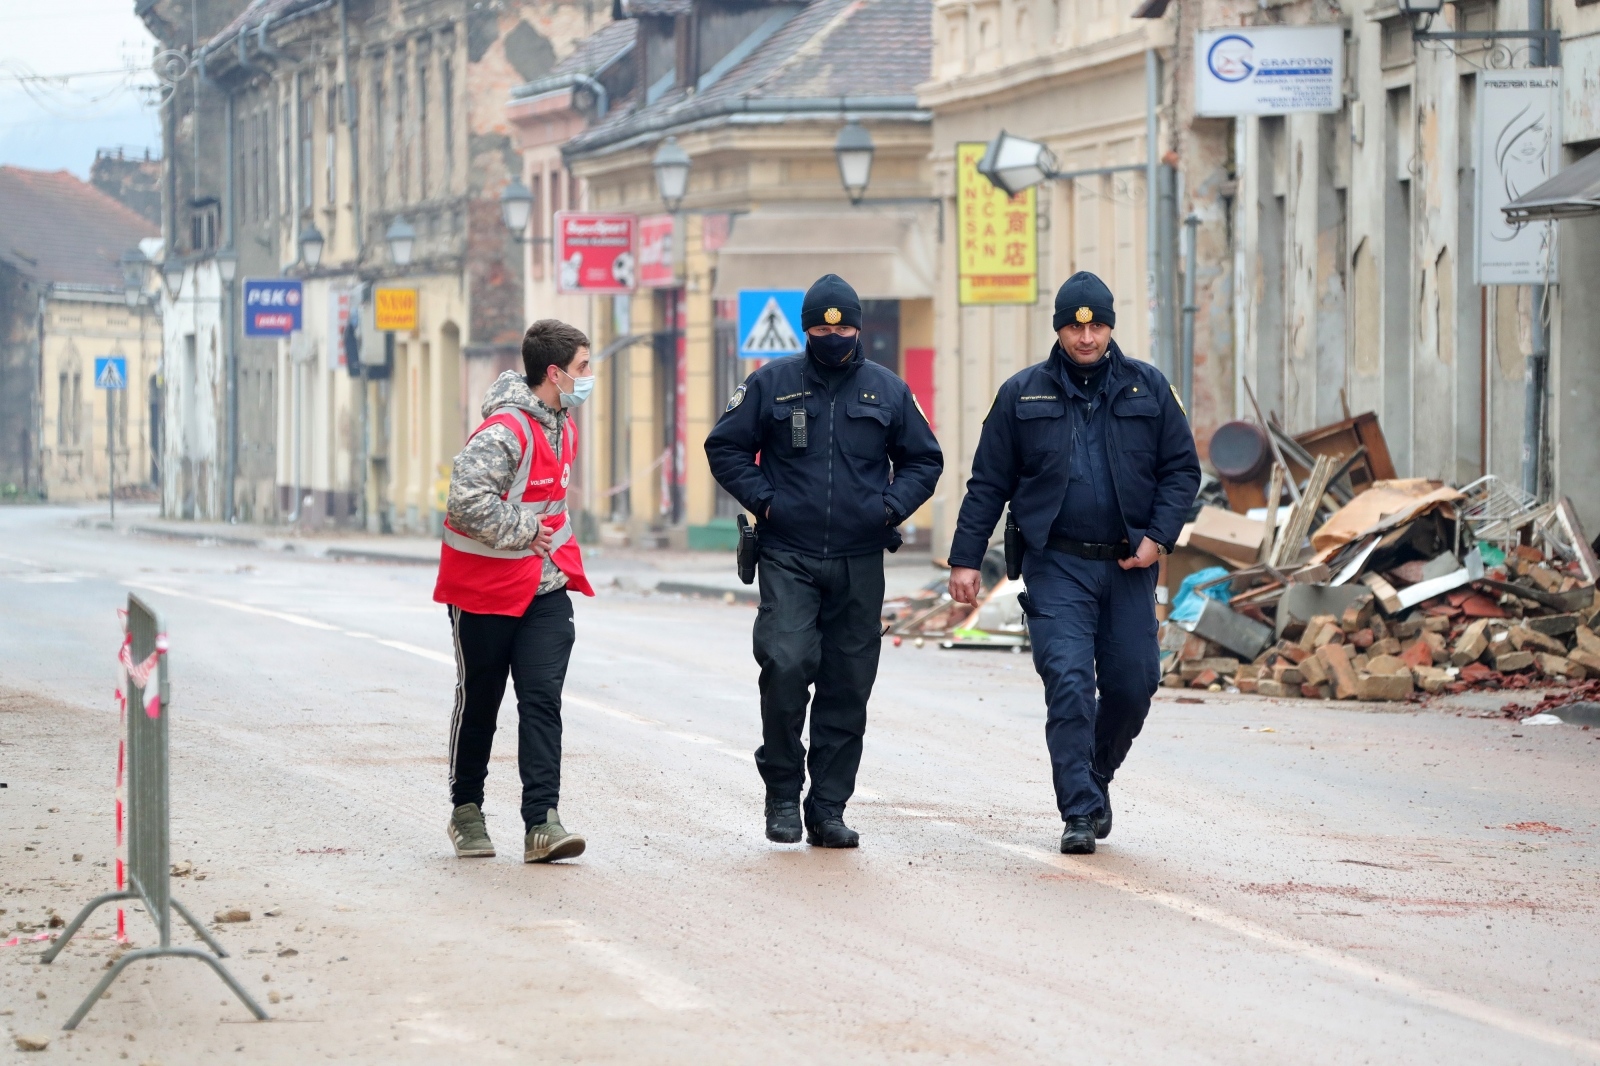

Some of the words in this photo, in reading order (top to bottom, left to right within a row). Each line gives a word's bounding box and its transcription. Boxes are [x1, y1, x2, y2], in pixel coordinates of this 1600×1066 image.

[1260, 57, 1333, 67] GRAFOTON
[1484, 80, 1527, 88] FRIZERSKI
[965, 153, 977, 267] KINESKI
[983, 180, 996, 258] UCAN
[247, 289, 286, 306] PSK
